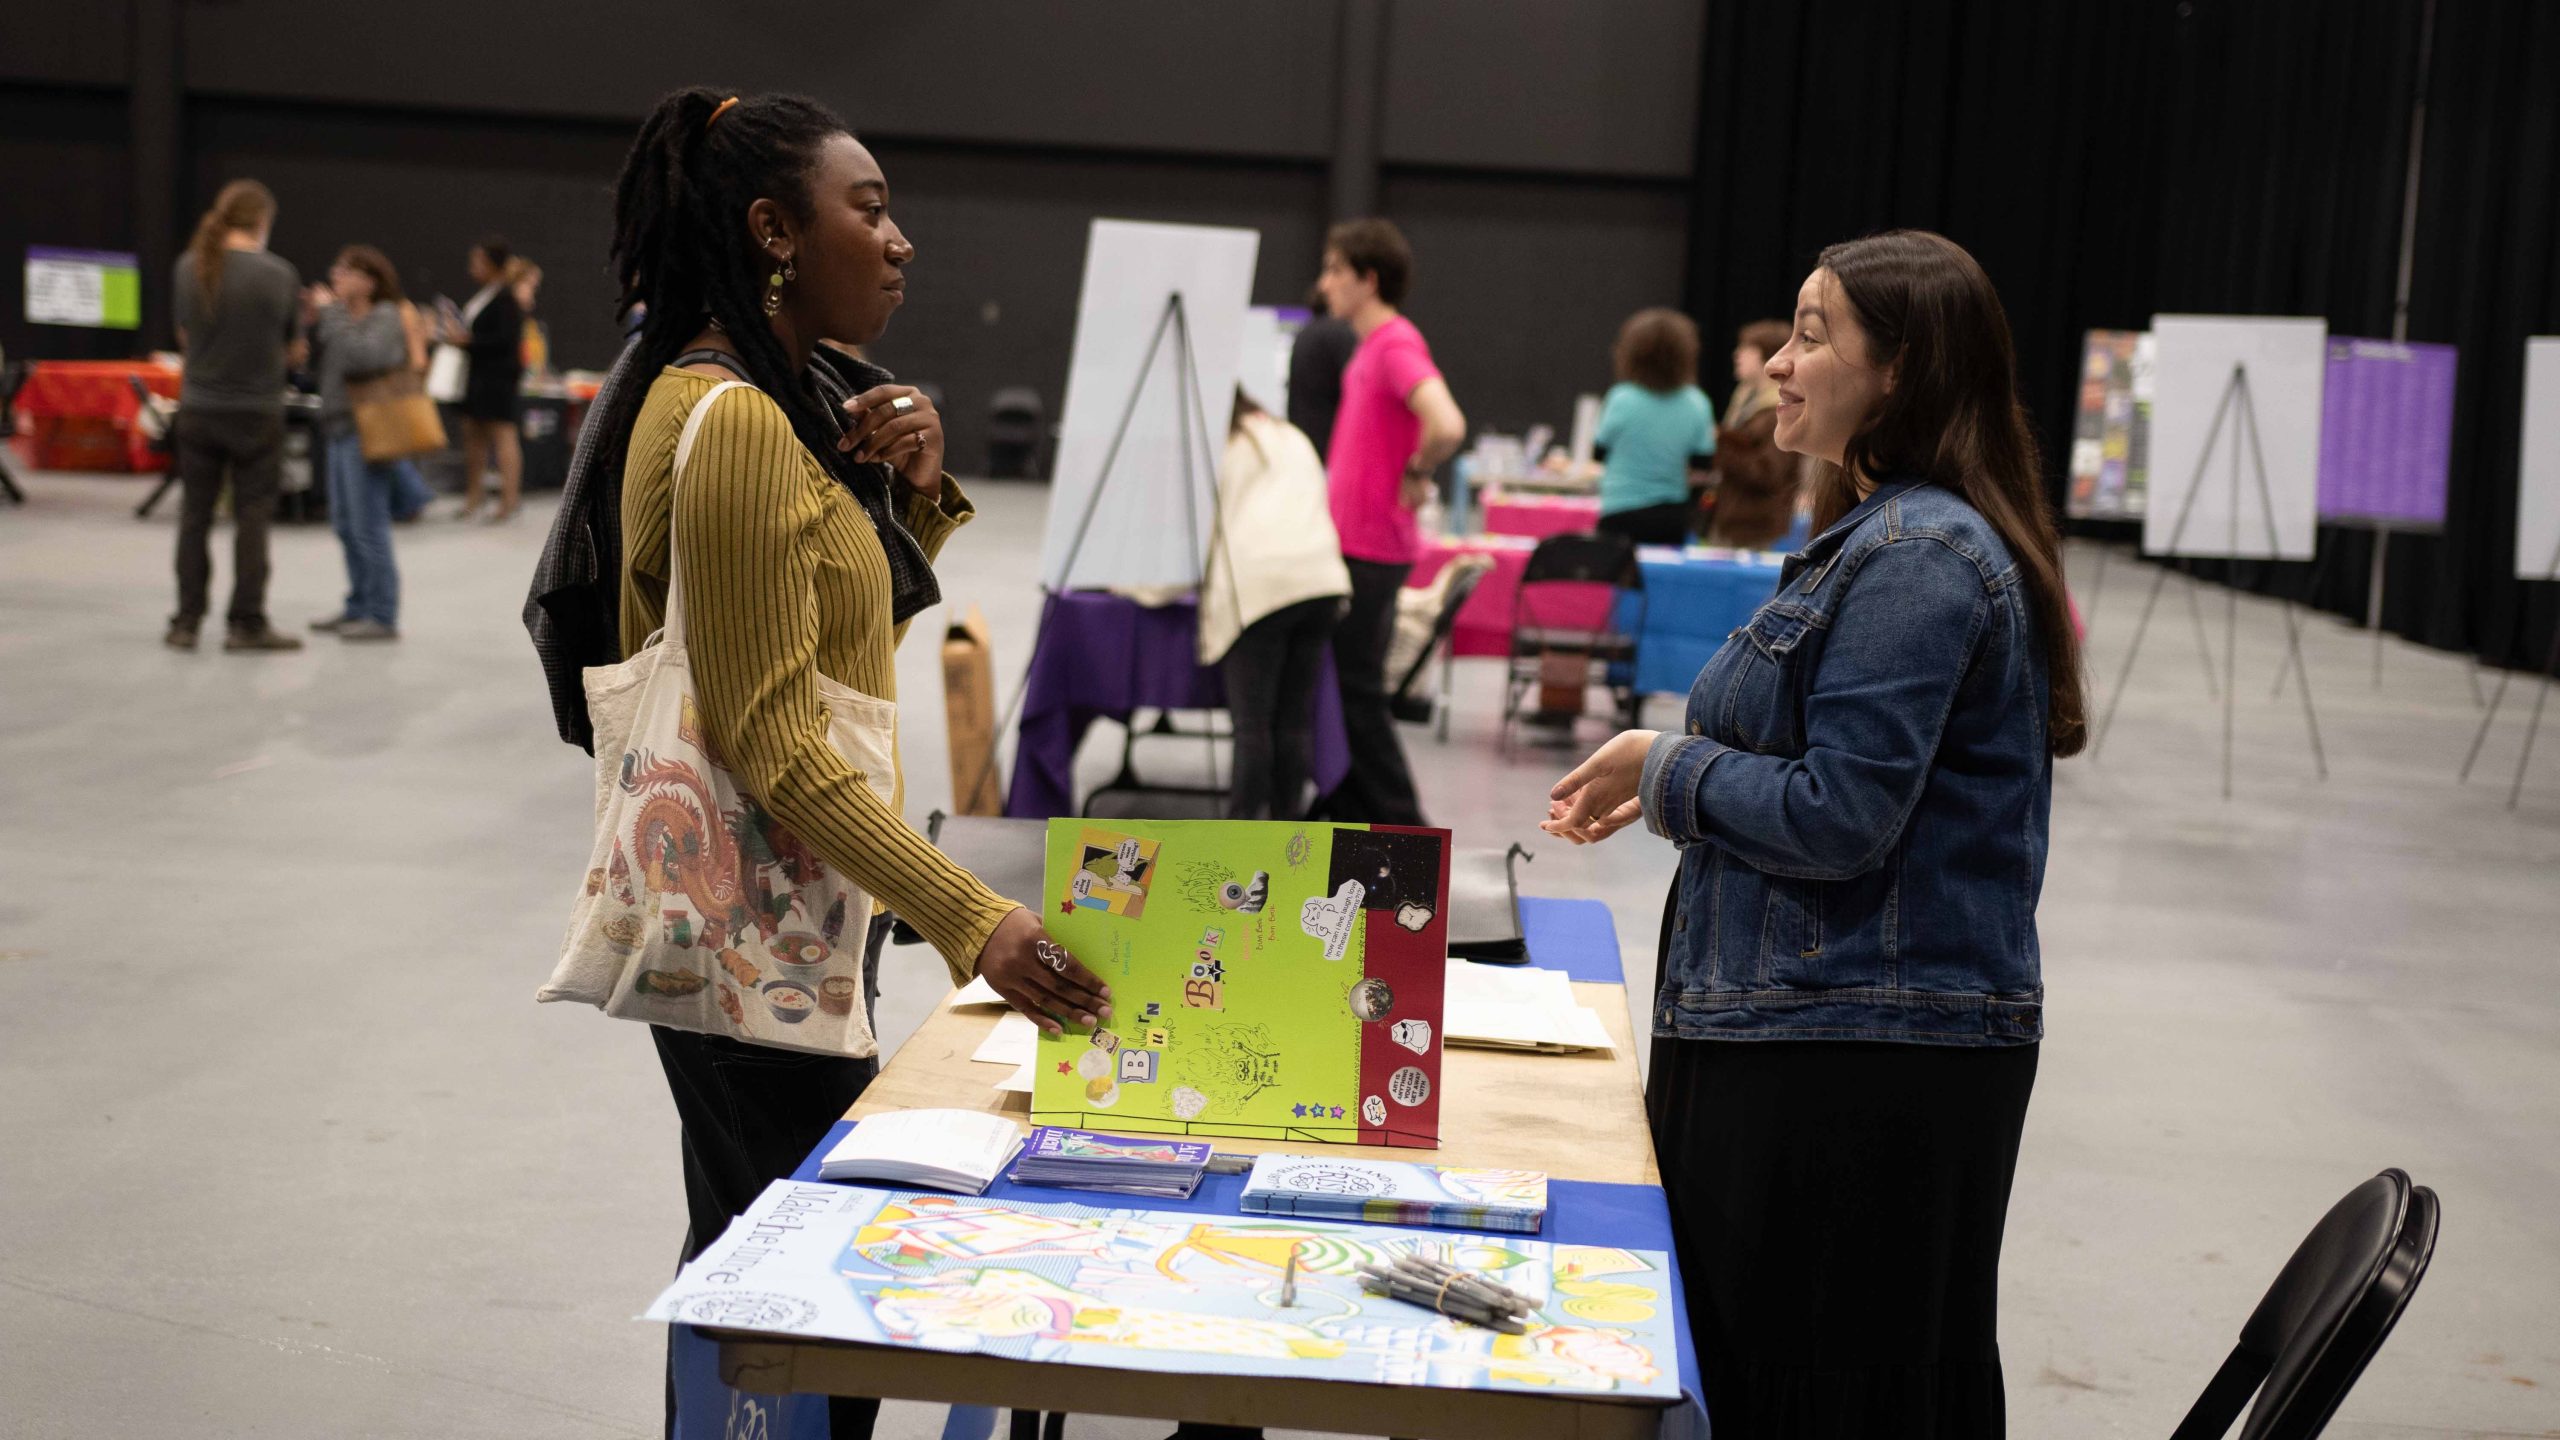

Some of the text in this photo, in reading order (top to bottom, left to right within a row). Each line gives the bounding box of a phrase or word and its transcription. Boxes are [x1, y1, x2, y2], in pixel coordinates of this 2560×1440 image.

[1325, 943, 1335, 958] how
[1331, 931, 1340, 943] can
[1336, 915, 1346, 928] live,
[1341, 895, 1353, 915] laugh,
[1347, 881, 1357, 895] love
[1337, 932, 1348, 950] these
[1397, 1069, 1408, 1100] ANYTHING
[1413, 1072, 1421, 1090] AWAY
[1418, 1080, 1426, 1097] WITH
[1341, 1165, 1392, 1182] ISLAND
[768, 1185, 838, 1220] Make
